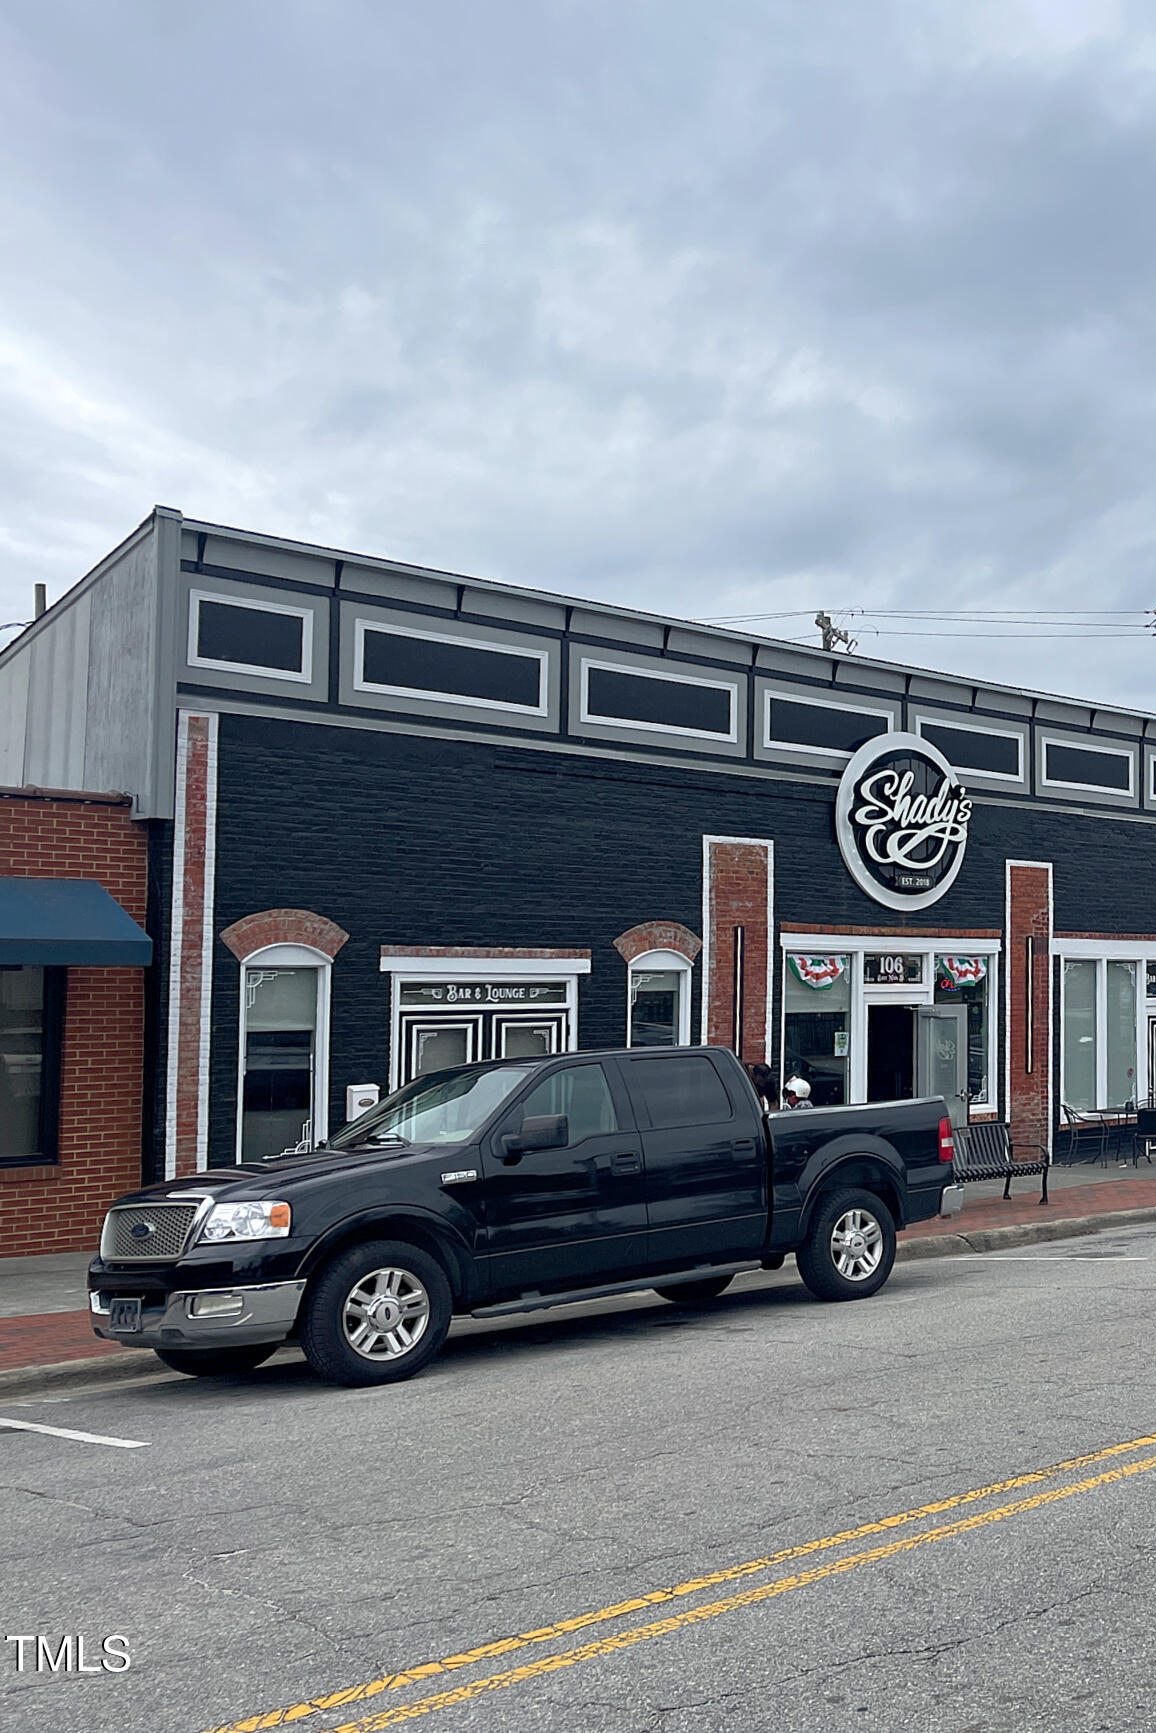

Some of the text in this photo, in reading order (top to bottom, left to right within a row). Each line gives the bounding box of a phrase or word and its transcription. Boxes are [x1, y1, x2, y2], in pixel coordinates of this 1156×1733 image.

[855, 769, 973, 870] Shady's
[901, 877, 930, 887] EST. 2018
[880, 956, 904, 974] 106
[446, 984, 525, 1002] BAR & LOUNGE
